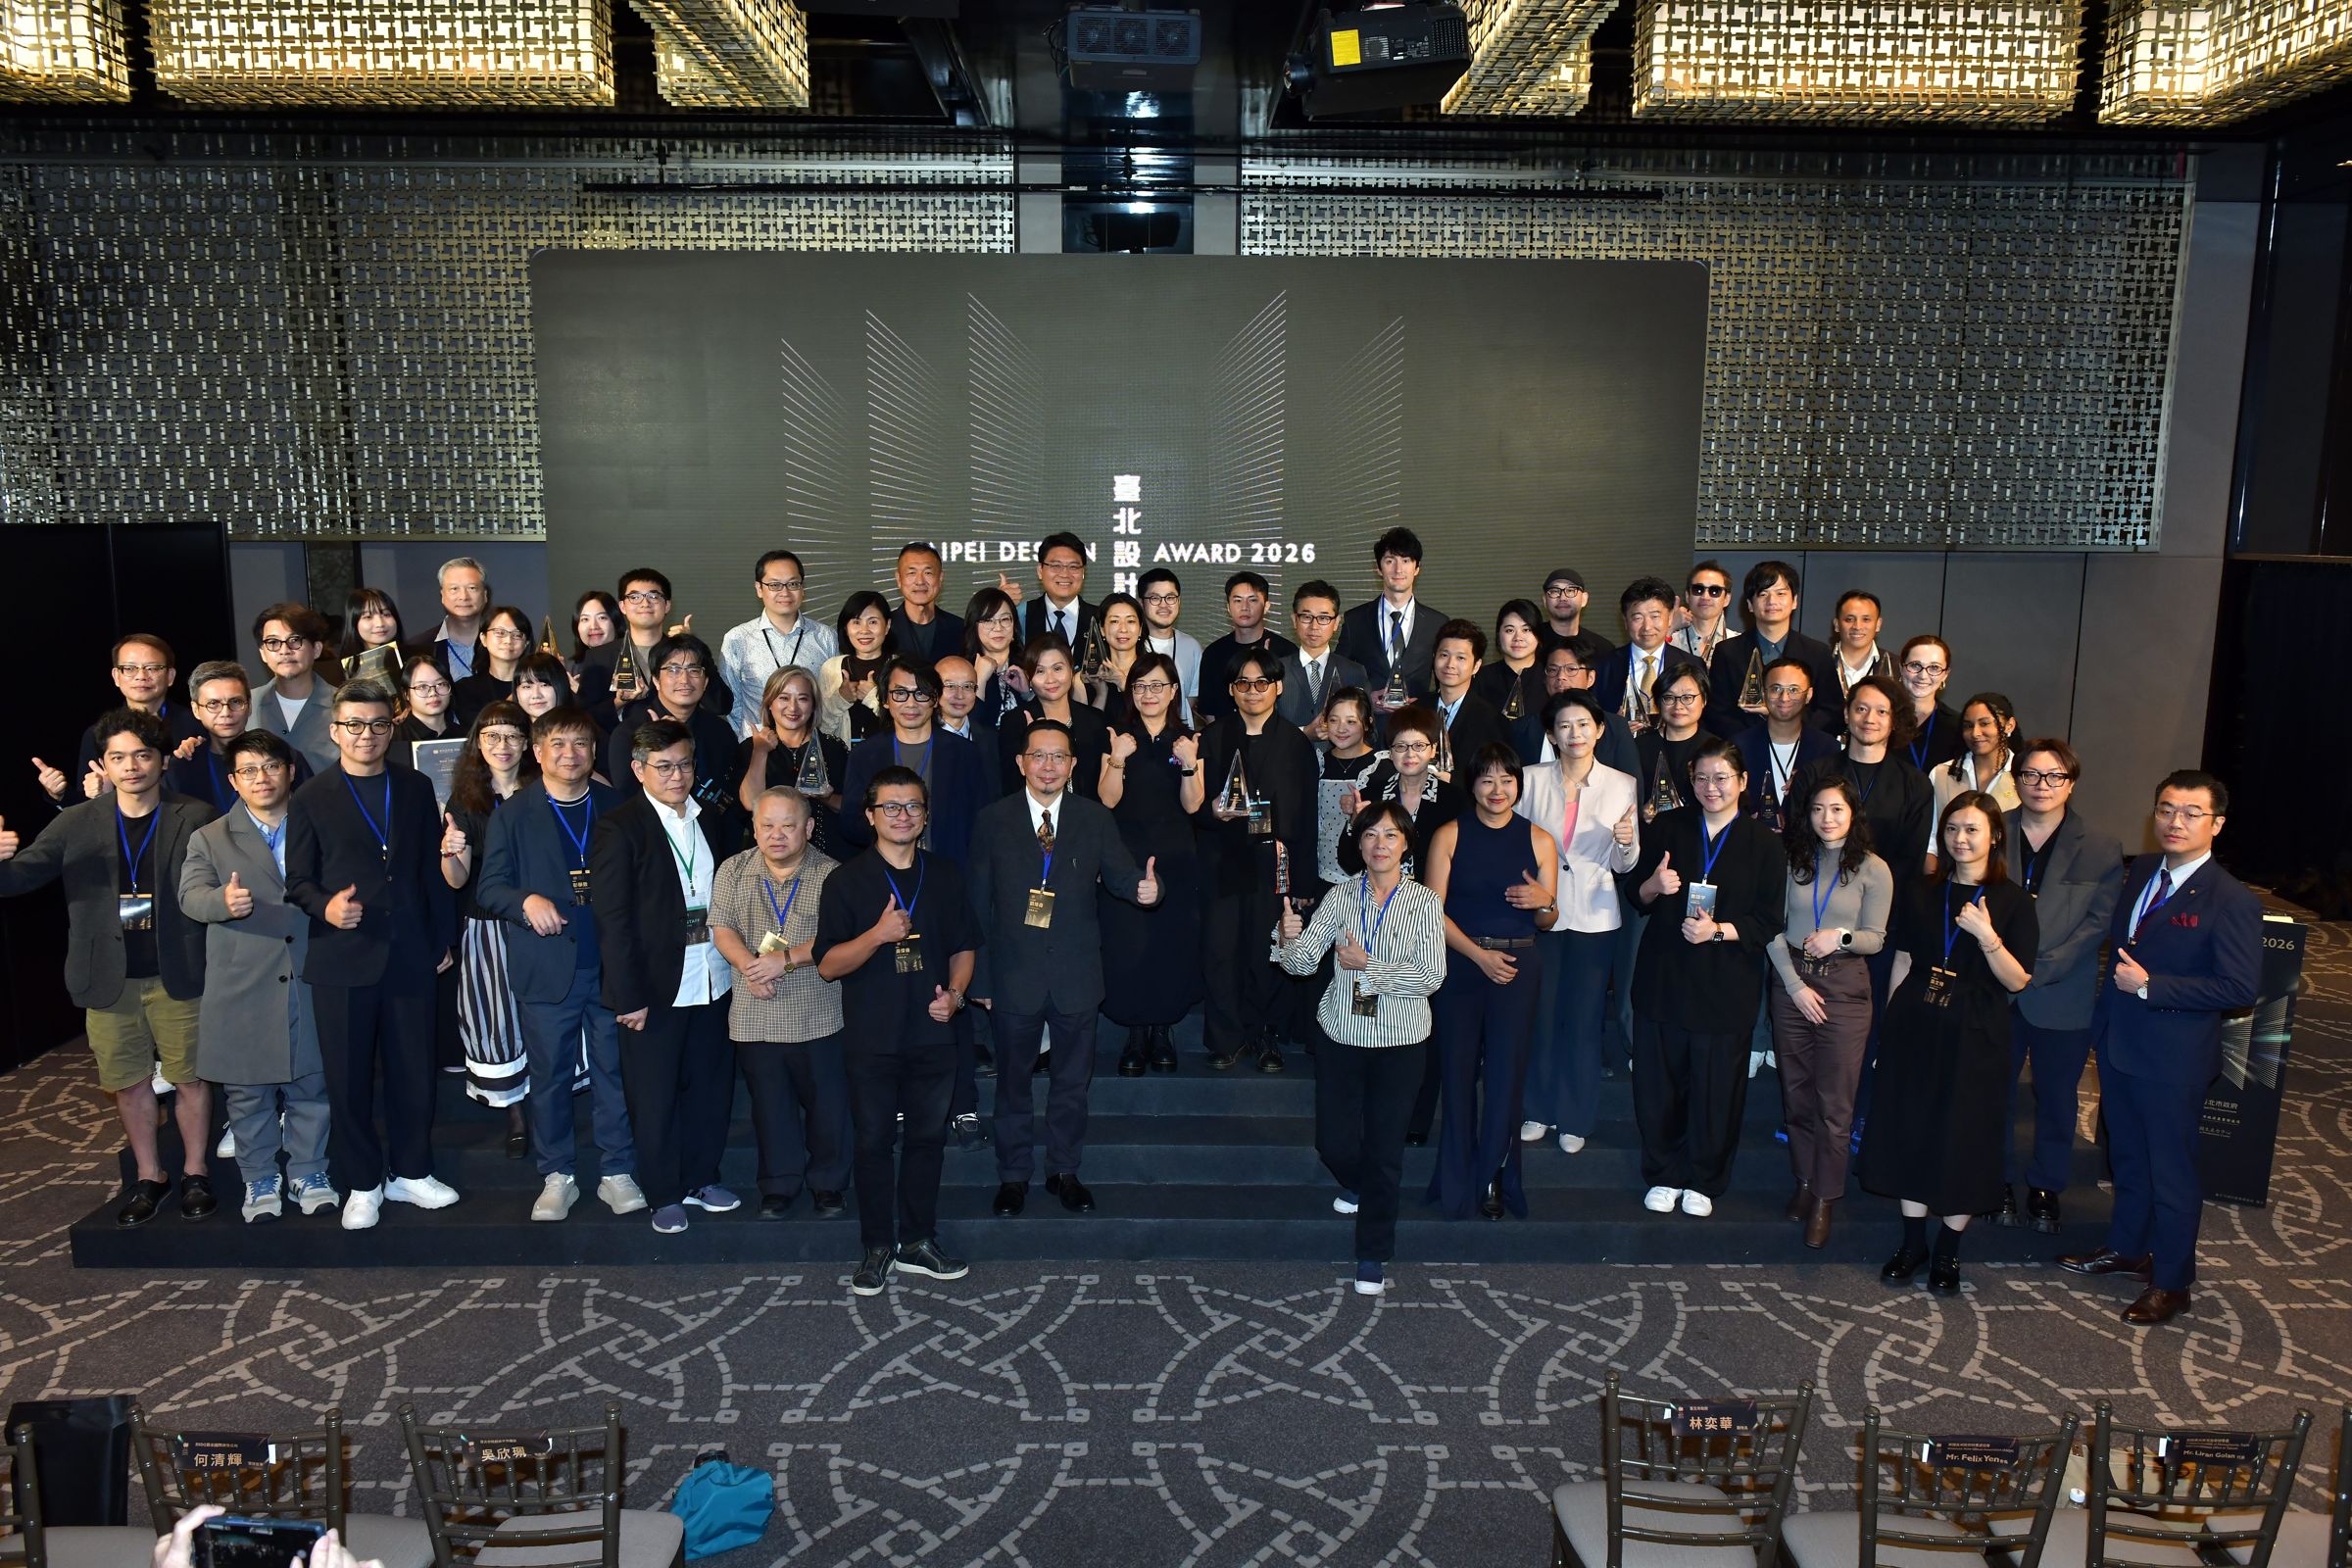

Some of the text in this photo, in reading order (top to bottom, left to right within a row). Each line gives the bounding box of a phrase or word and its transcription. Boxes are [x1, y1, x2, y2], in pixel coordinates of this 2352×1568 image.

[1152, 542, 1242, 564] AWARD
[1250, 542, 1316, 564] 2026
[2262, 936, 2295, 951] 2026
[1689, 1415, 1733, 1431] 林奕華
[193, 1452, 244, 1467] 何清輝
[1961, 1453, 1984, 1463] Felix
